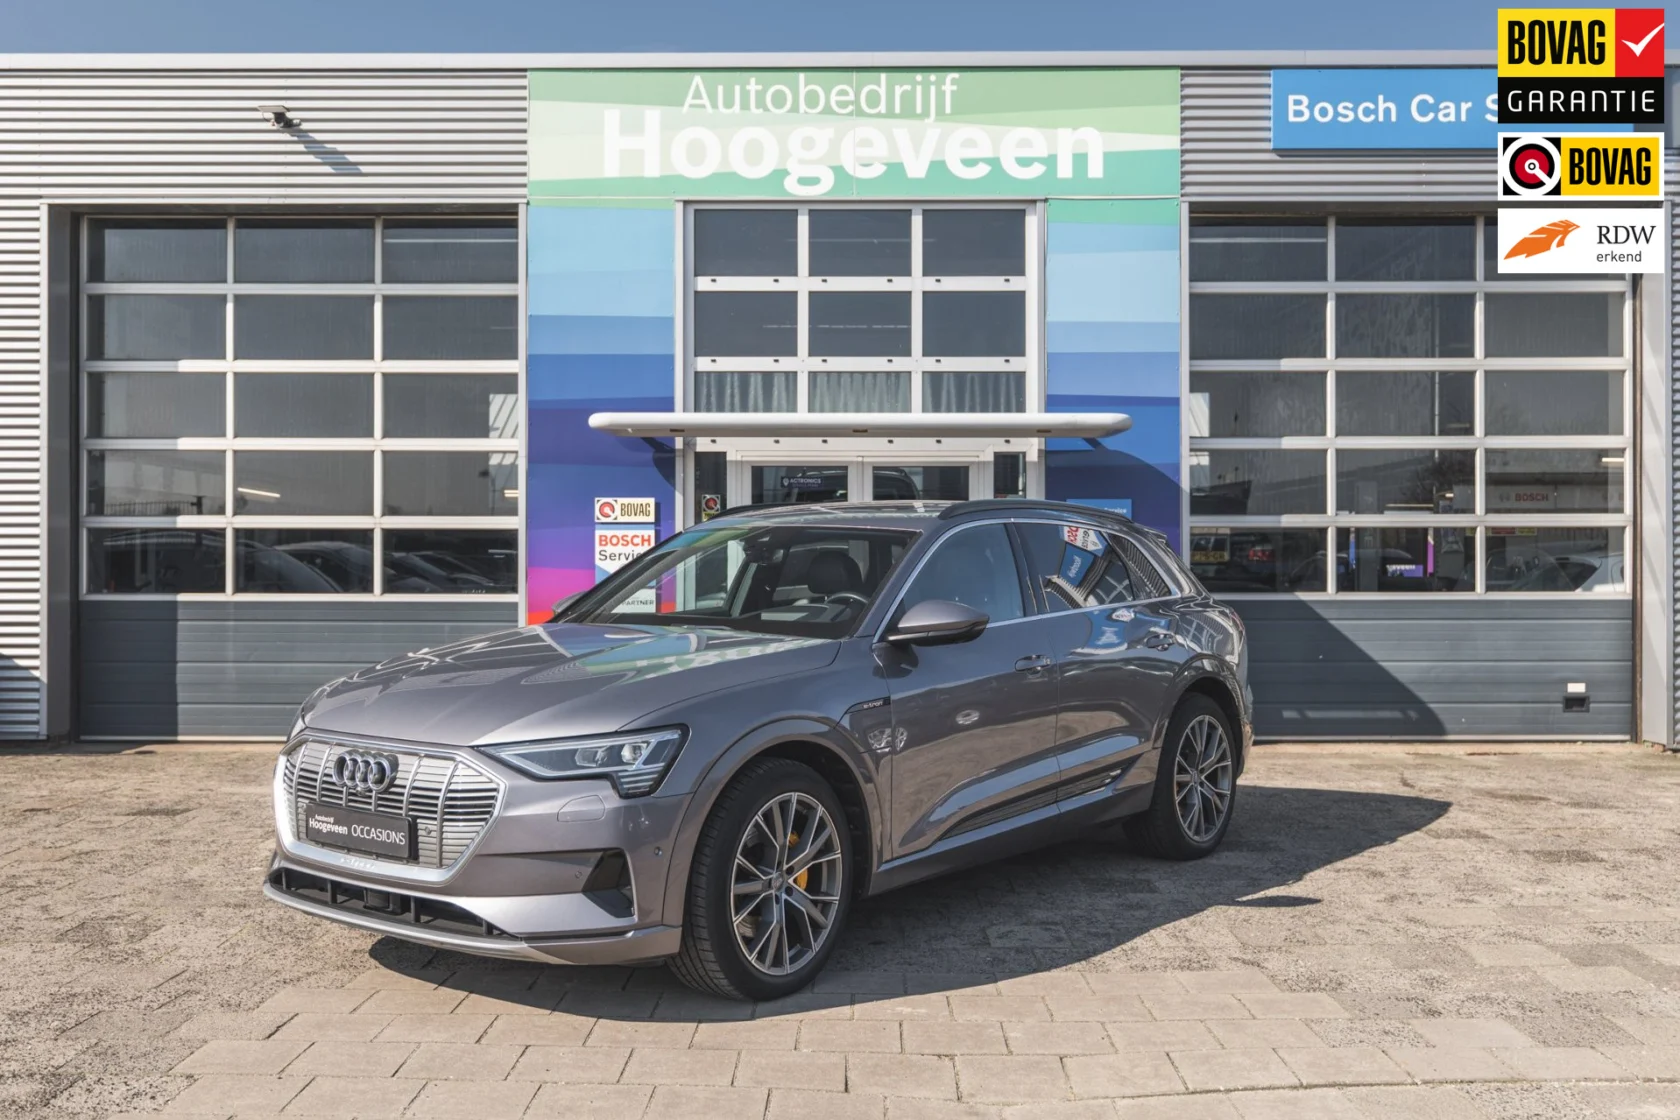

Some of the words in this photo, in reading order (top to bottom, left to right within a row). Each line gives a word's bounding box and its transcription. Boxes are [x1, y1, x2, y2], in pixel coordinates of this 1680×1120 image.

[682, 73, 959, 122] Autobedrijf
[1288, 95, 1397, 123] Bosch
[1410, 94, 1472, 122] Car
[603, 108, 1104, 196] Hoogeveen
[1515, 492, 1548, 501] BOSCH
[620, 503, 651, 516] BOVAG
[599, 535, 651, 547] BOSCH
[599, 549, 641, 561] Servi
[309, 817, 348, 835] Hoogeveen
[351, 824, 406, 845] OCCASIONS
